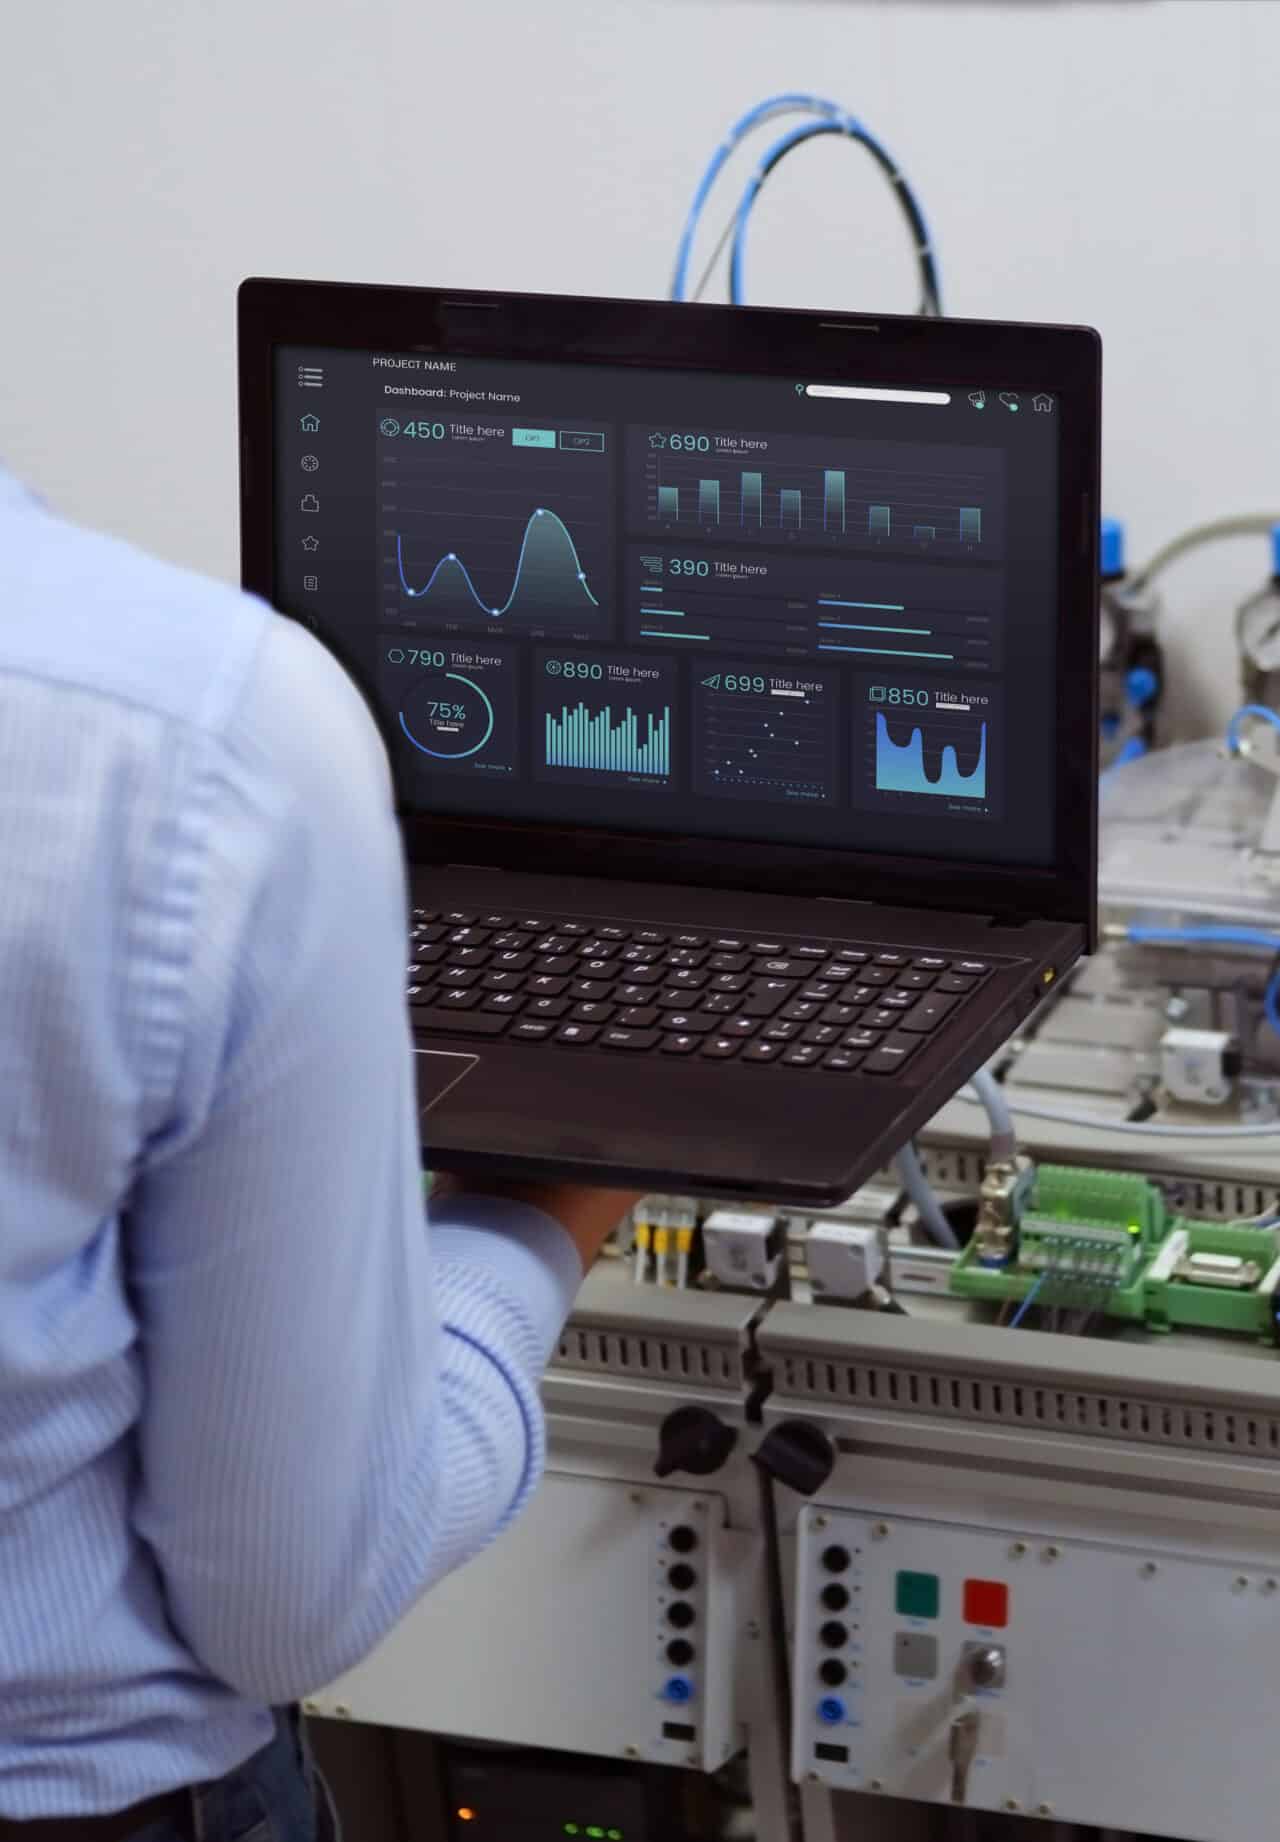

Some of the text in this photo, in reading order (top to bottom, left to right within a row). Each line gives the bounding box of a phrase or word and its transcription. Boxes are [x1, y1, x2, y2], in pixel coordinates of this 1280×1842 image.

[372, 358, 457, 372] PROJECT NAME
[384, 385, 521, 402] Dashboard: Project Name
[402, 420, 446, 440] 450
[449, 423, 474, 436] Title
[476, 425, 505, 438] here
[669, 434, 710, 452] 690
[714, 436, 738, 448] Title
[740, 439, 769, 450] here
[669, 559, 709, 577] 390
[713, 561, 738, 573] Title
[740, 564, 768, 575] here
[407, 649, 445, 667] 790
[450, 652, 473, 664] Title
[475, 654, 502, 666] here
[563, 661, 603, 680] 890
[607, 665, 631, 677] Title
[632, 667, 660, 679] here
[724, 675, 824, 693] 699 Title here
[888, 686, 989, 706] 850 Title here
[426, 701, 467, 720] 75%
